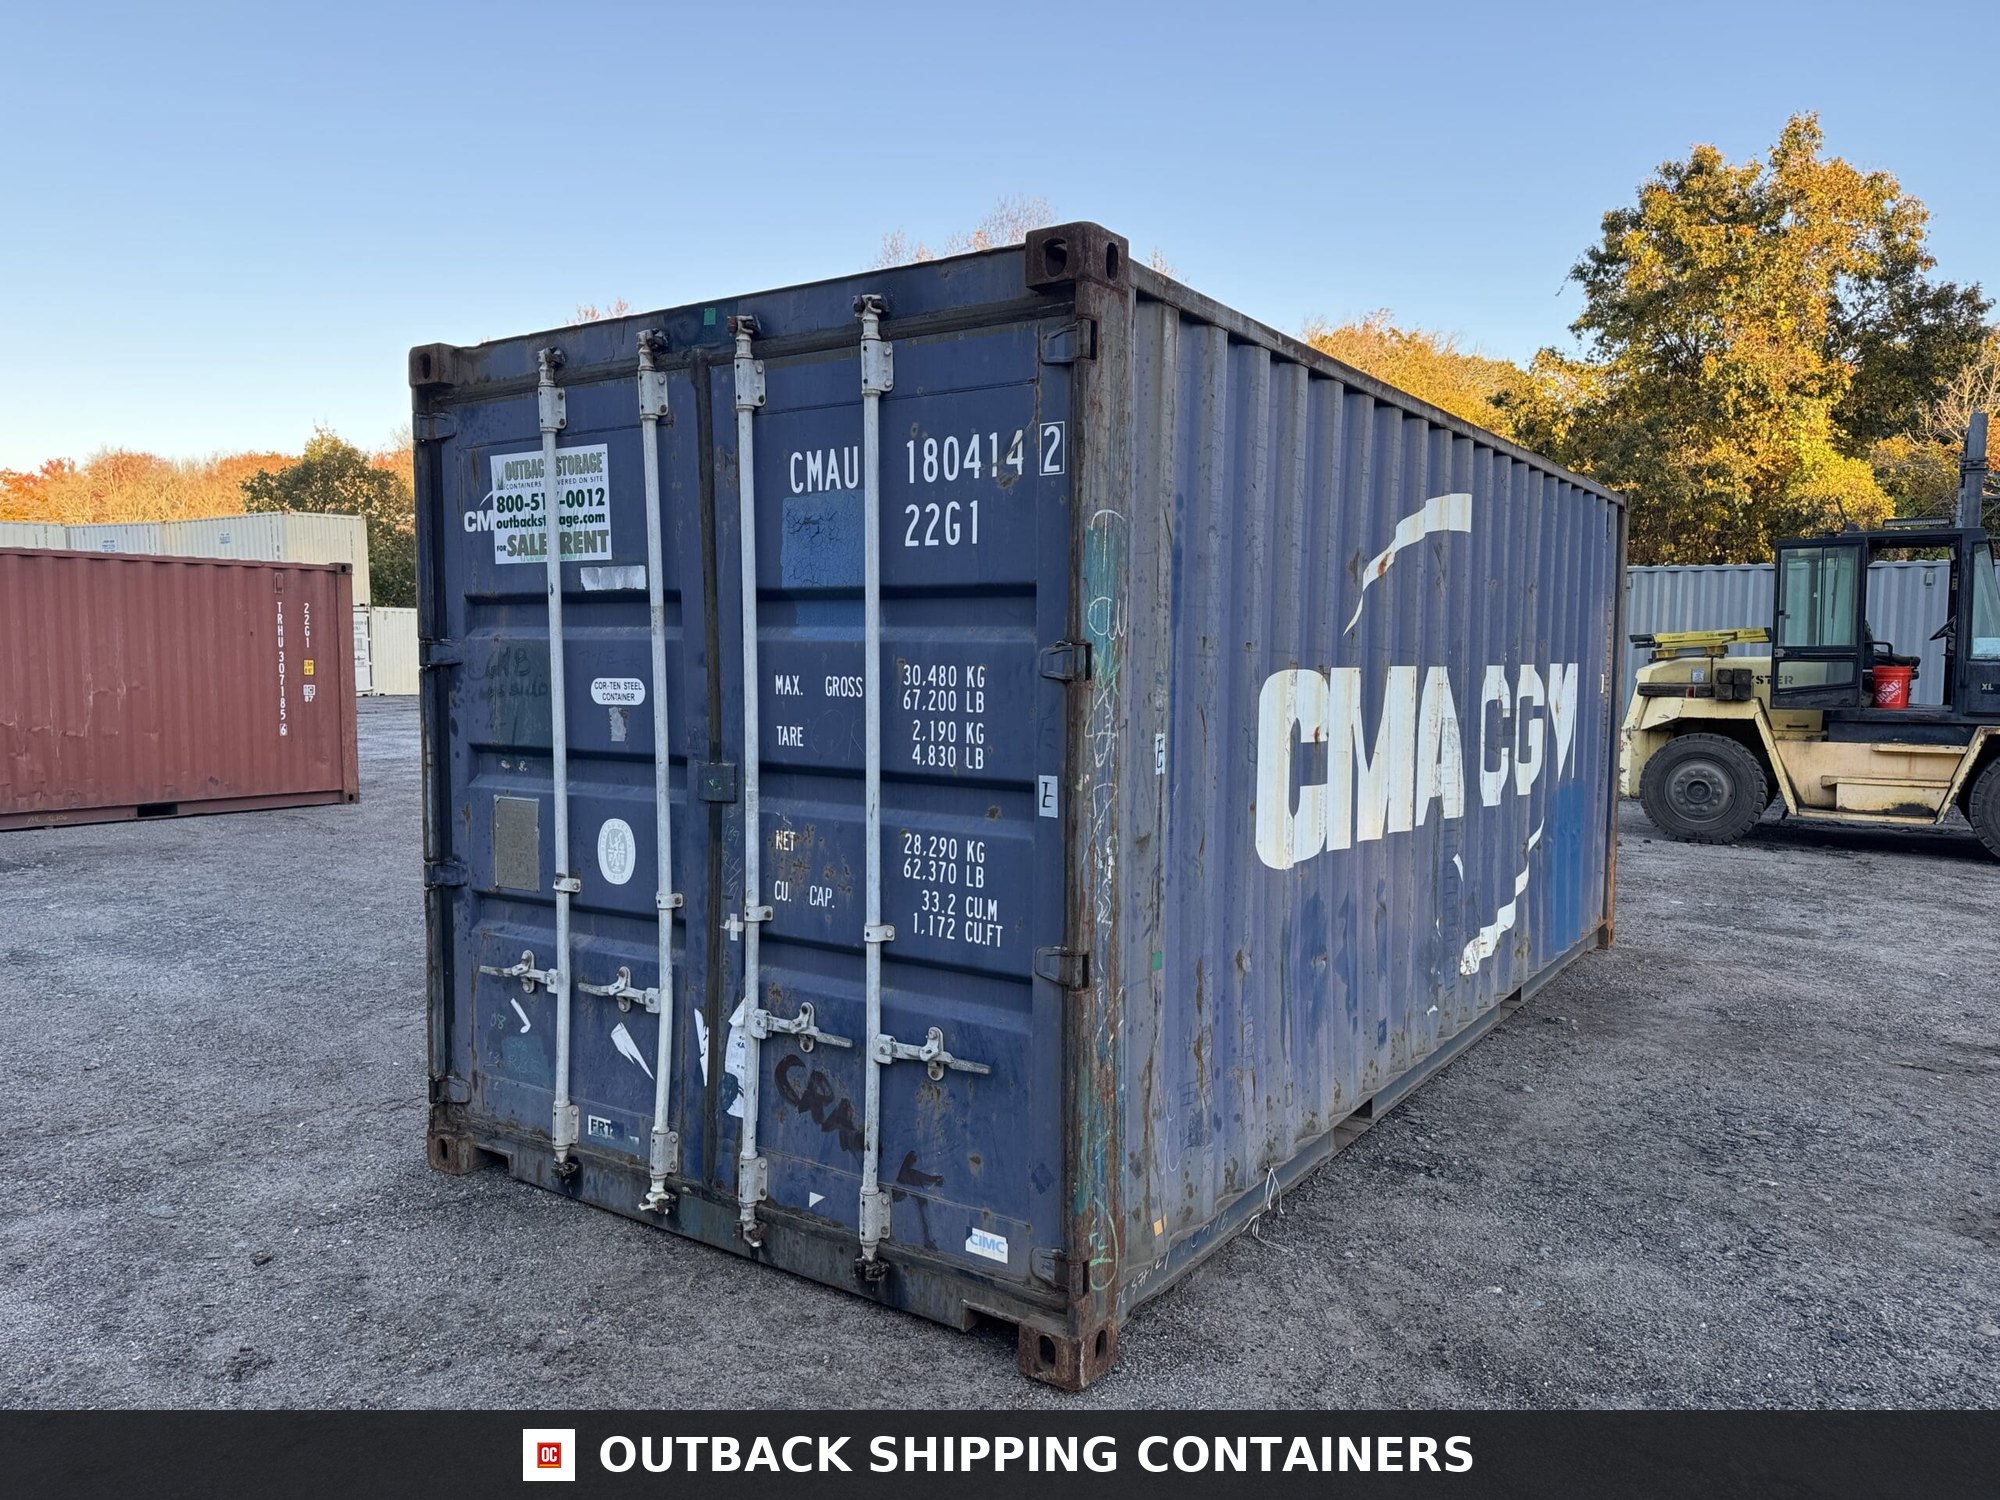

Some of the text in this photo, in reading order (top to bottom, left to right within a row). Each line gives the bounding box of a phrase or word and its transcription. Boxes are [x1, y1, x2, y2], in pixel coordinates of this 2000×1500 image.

[504, 458, 545, 481] OUTBAC
[790, 425, 1062, 493] CMAU 180414 2
[496, 487, 605, 513] 800-51-0012
[905, 501, 979, 547] 22G1
[560, 529, 609, 554] RENT
[303, 602, 311, 648] 22G1
[276, 601, 288, 736] TRHU 307185 6
[775, 665, 985, 698] MAX. GROSS 30,480 KG
[594, 681, 642, 690] COR-TEN STEEL
[602, 693, 635, 701] CONTAINER
[1981, 683, 1994, 691] XL
[903, 690, 985, 713] 67,200 LB
[777, 720, 985, 747] TARE 2,190 KG
[912, 745, 984, 770] 4,830 LB
[1255, 665, 1465, 870] CMA
[1479, 662, 1579, 807] CGM
[775, 830, 985, 863] NET 28,290 KG
[903, 858, 984, 889] 62,370 LB
[774, 881, 998, 922] CU. CAP. 33.2 CU.M
[913, 912, 1003, 948] 1,172 CU.FT
[970, 1233, 1005, 1254] CIMC
